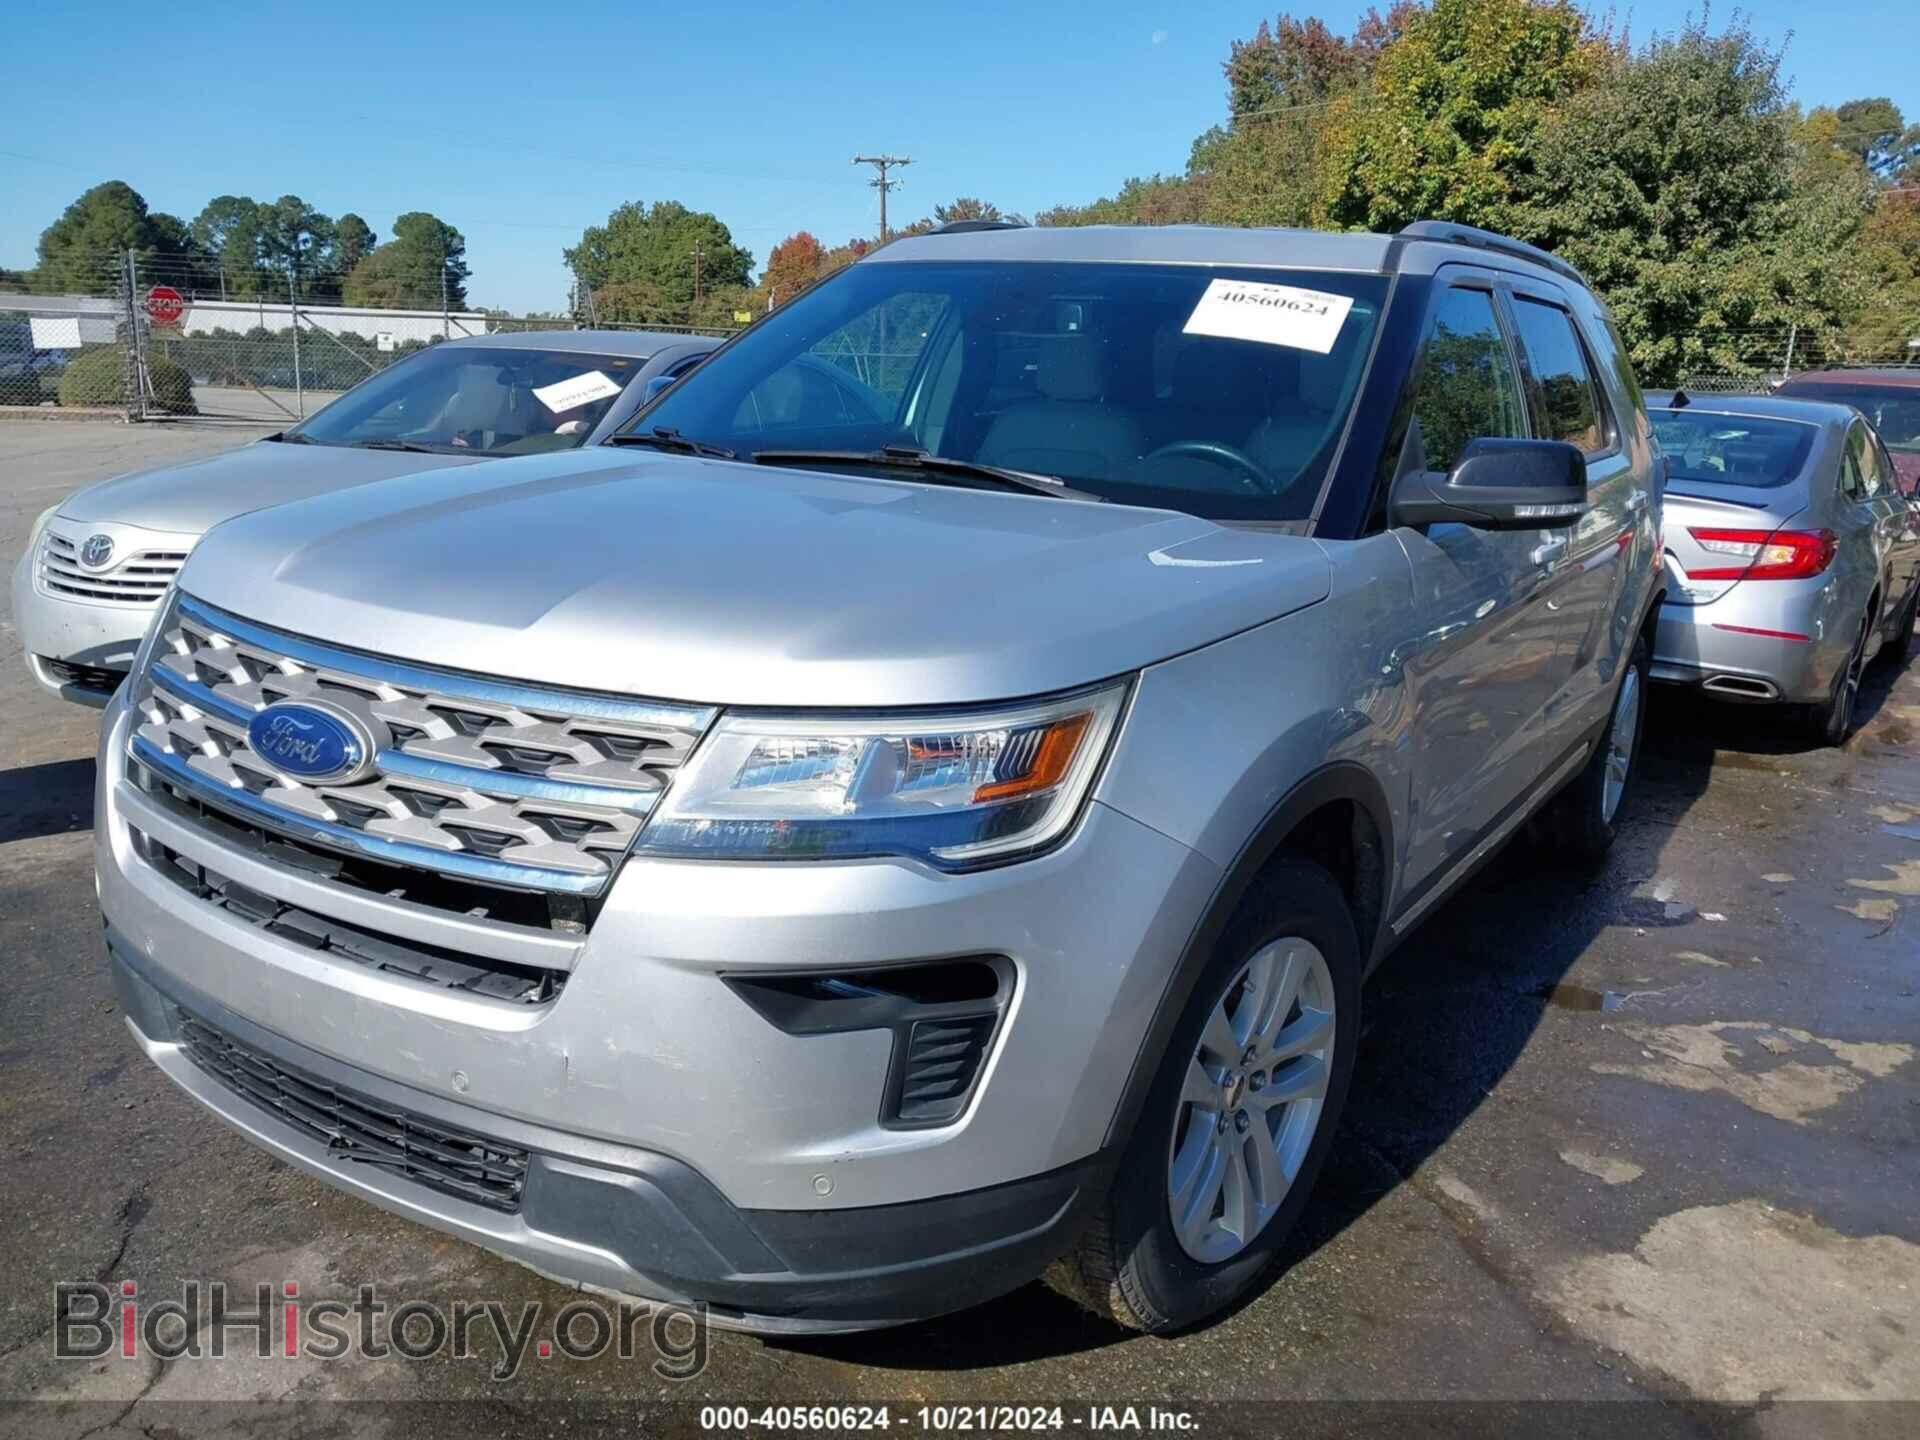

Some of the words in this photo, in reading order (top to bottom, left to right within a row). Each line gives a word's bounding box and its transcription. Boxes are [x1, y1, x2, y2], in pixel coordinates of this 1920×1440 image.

[148, 298, 181, 312] STOP
[1217, 291, 1329, 315] 40560624
[262, 716, 325, 764] Ford
